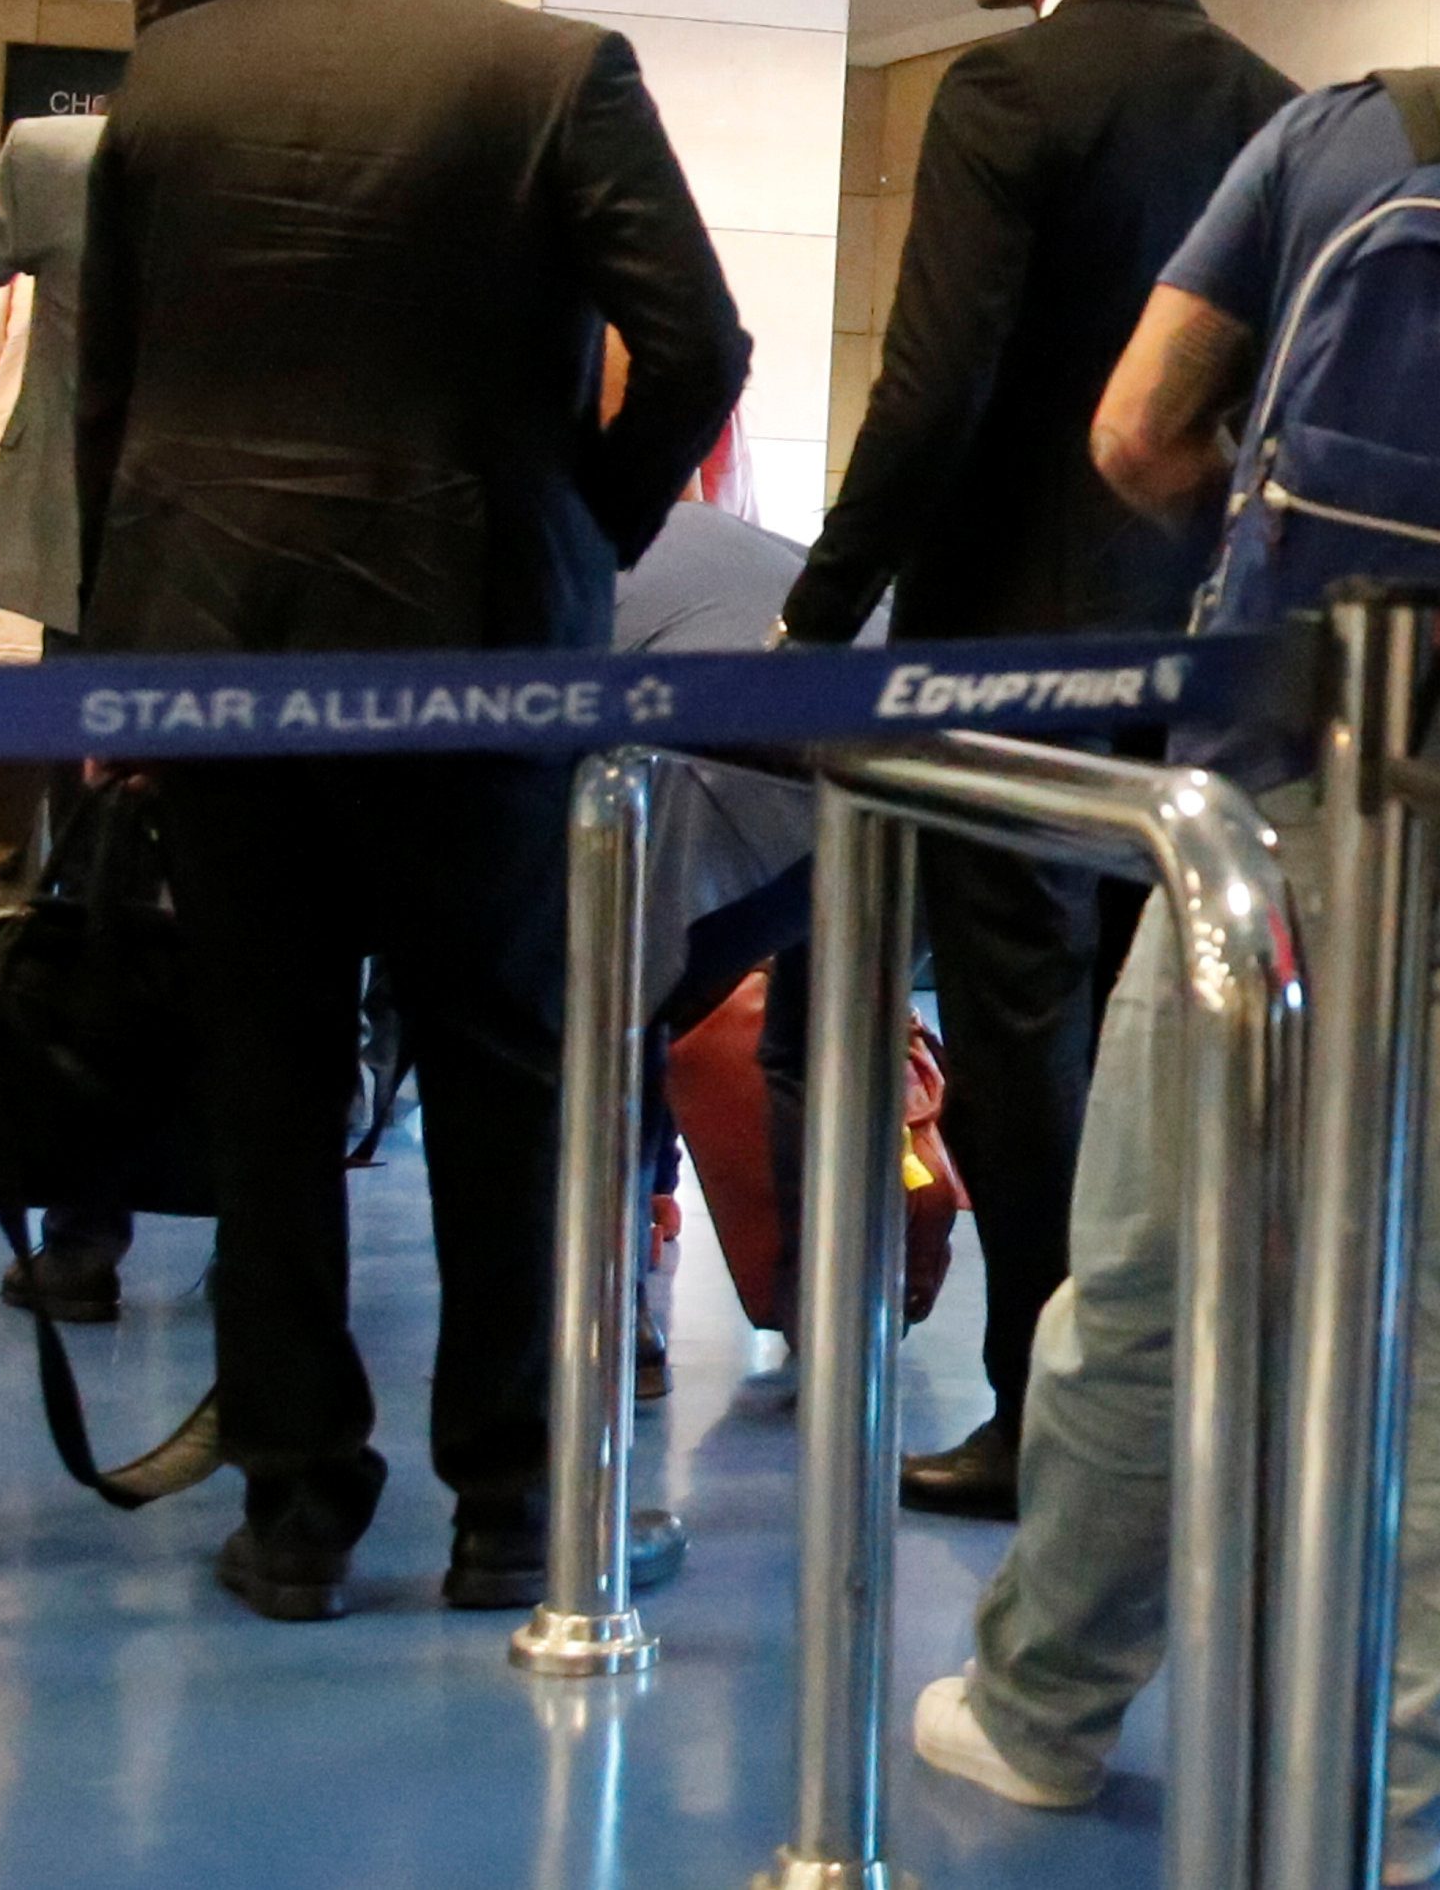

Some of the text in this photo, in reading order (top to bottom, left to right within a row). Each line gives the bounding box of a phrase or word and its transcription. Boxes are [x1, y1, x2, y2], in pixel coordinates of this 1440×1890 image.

[80, 681, 601, 735] STAR ALLIANCE
[874, 663, 1147, 719] EGYPTAIR
